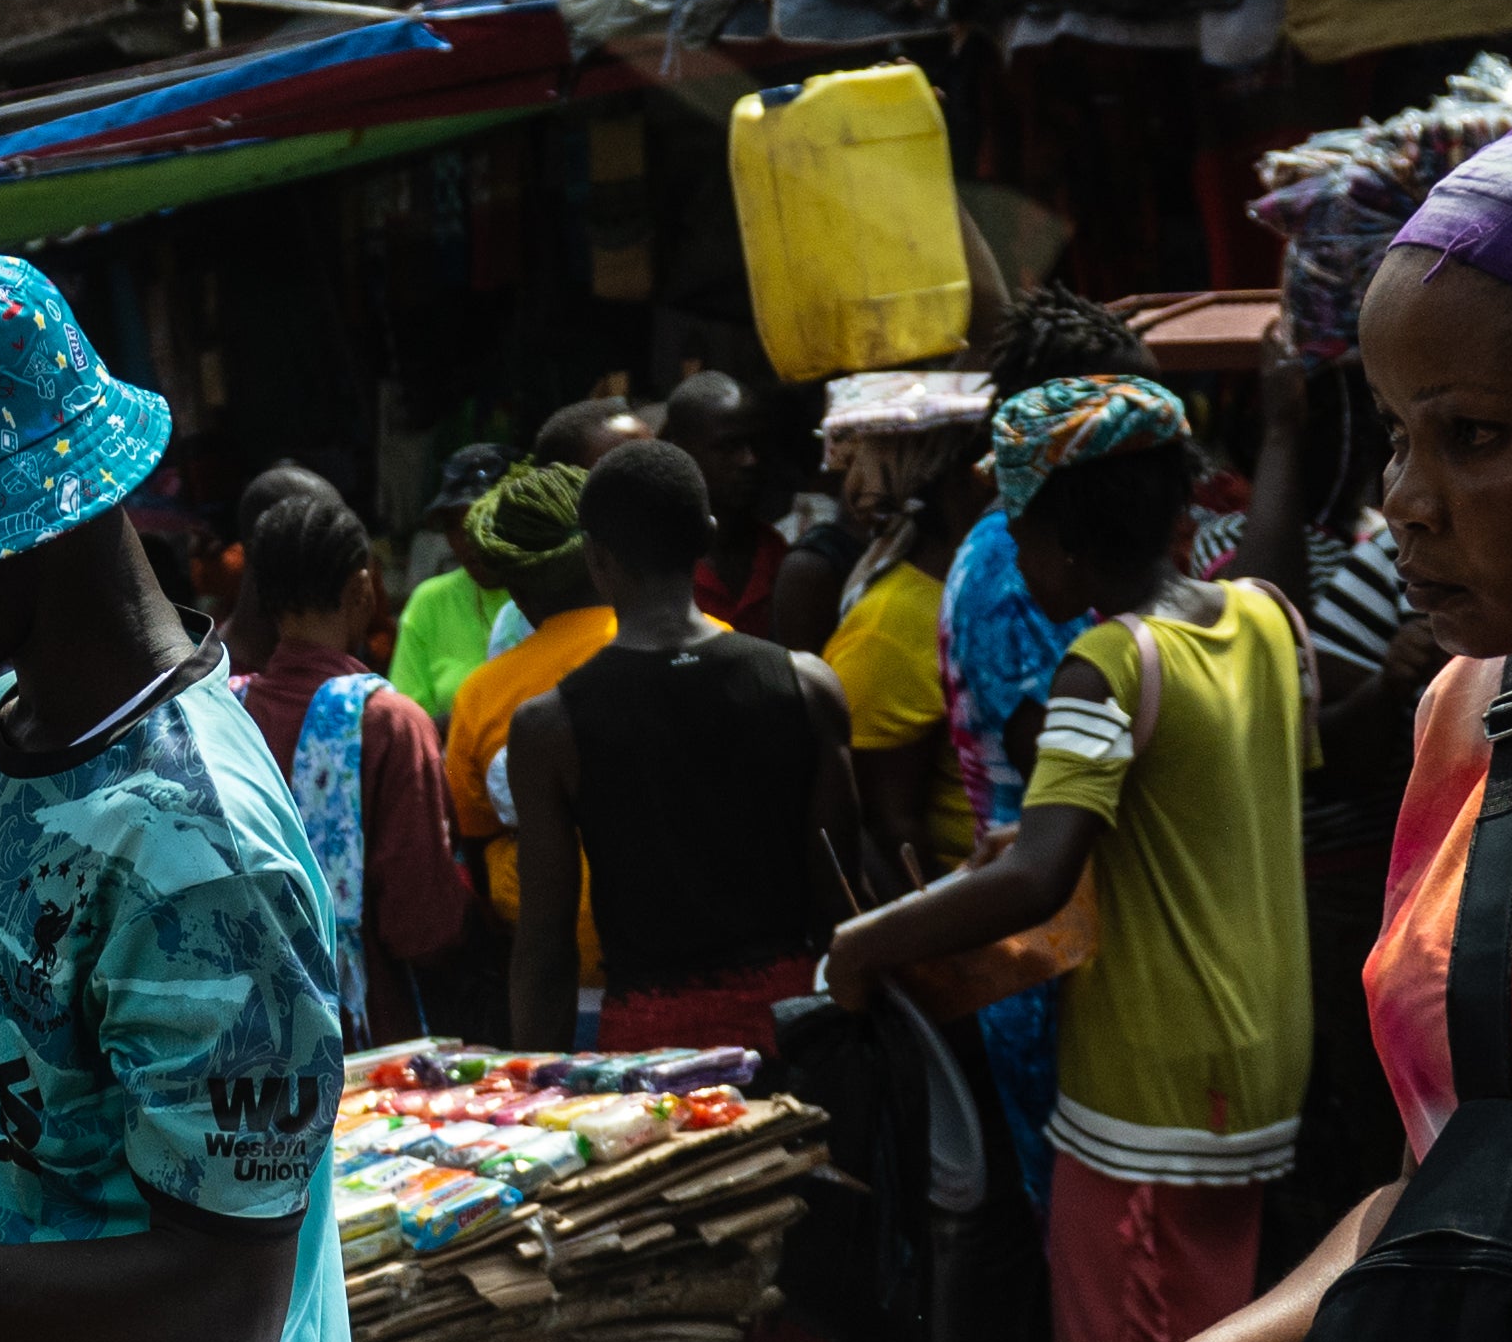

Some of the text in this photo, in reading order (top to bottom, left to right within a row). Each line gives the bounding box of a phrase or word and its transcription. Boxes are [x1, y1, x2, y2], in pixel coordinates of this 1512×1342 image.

[207, 1075, 320, 1134] WU
[204, 1131, 308, 1160] Western
[233, 1158, 310, 1183] Union
